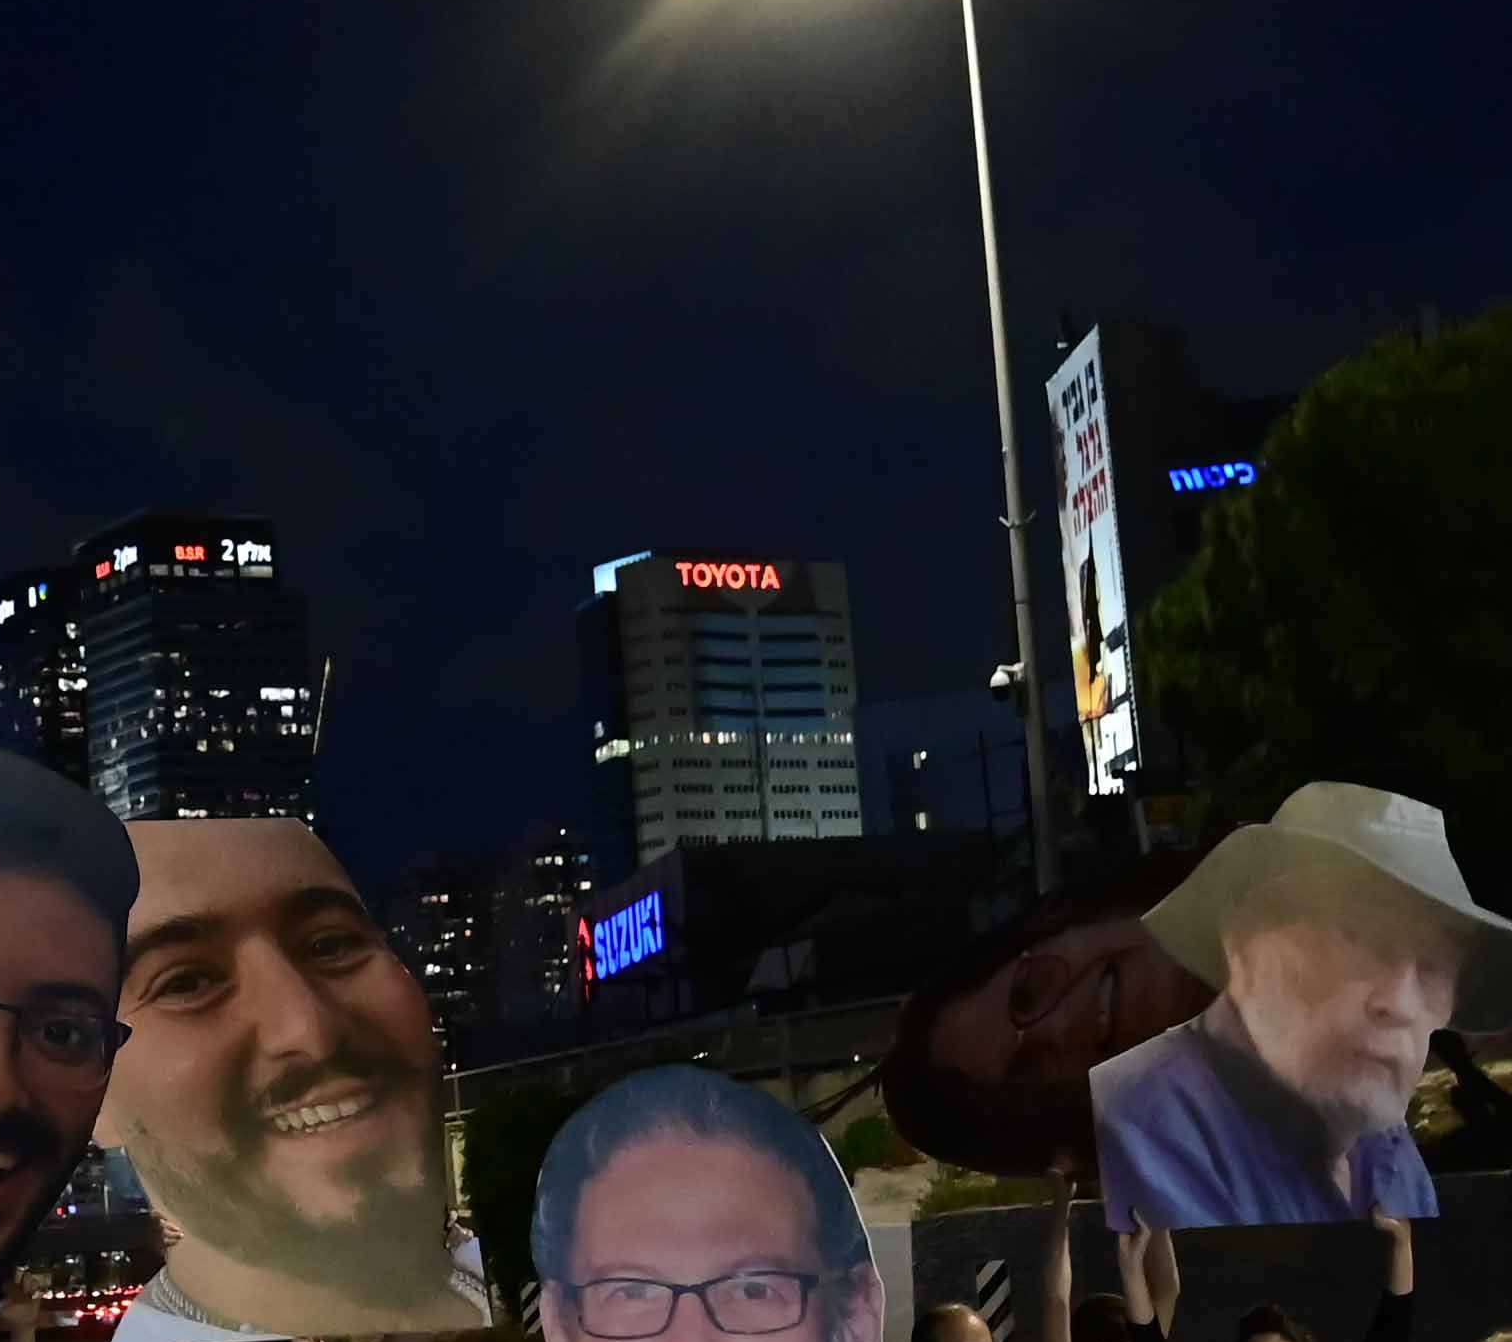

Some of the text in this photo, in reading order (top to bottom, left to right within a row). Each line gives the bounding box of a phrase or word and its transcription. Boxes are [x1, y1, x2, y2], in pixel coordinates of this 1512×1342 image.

[221, 539, 234, 561] 2
[675, 562, 780, 589] TOYOTA
[594, 890, 662, 980] SUZUKI
